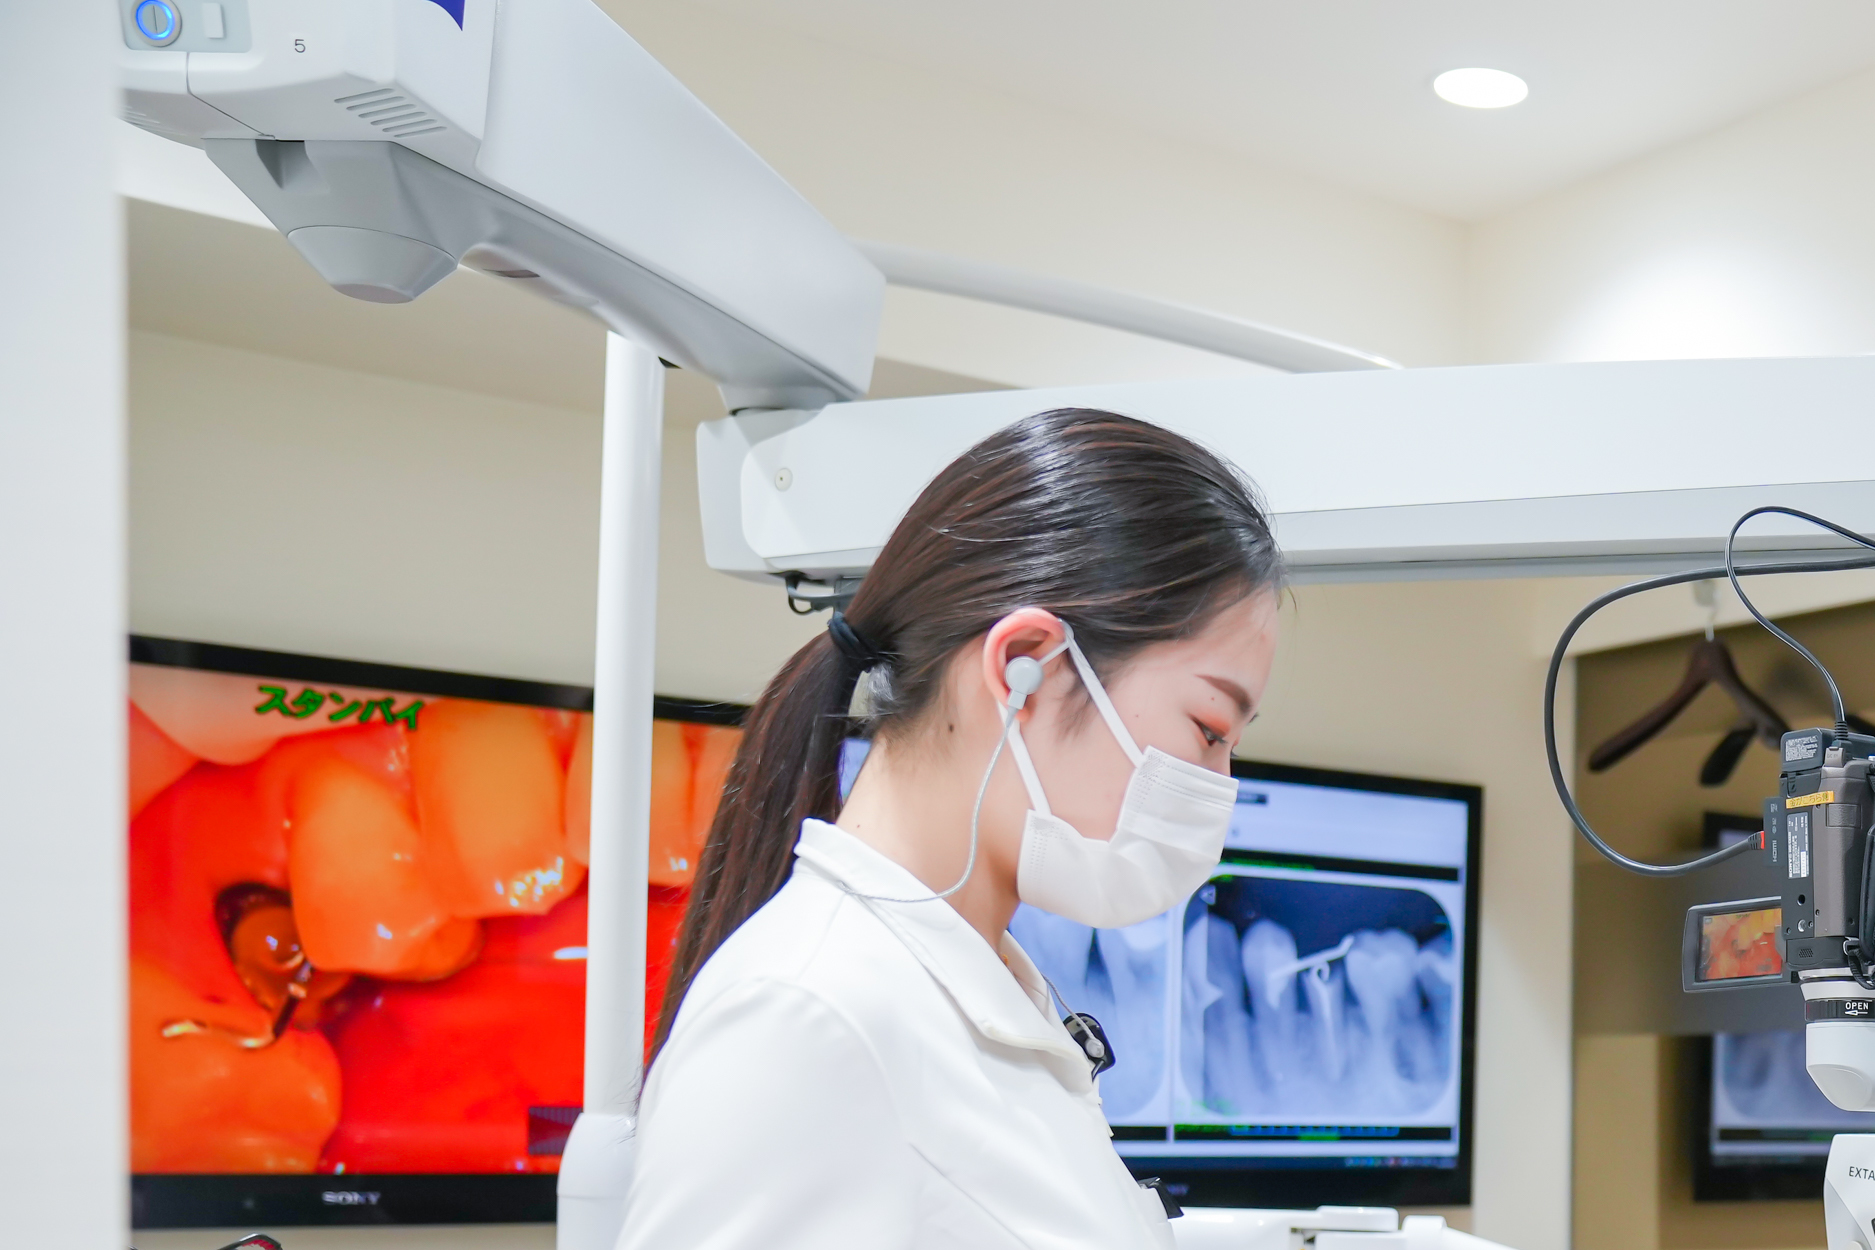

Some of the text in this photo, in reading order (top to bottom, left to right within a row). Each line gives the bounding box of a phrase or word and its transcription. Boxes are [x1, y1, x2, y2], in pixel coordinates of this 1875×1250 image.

[293, 38, 306, 53] 5
[255, 684, 425, 731] スタンバイ
[1845, 1002, 1869, 1010] OPEN
[322, 1190, 381, 1205] SONY
